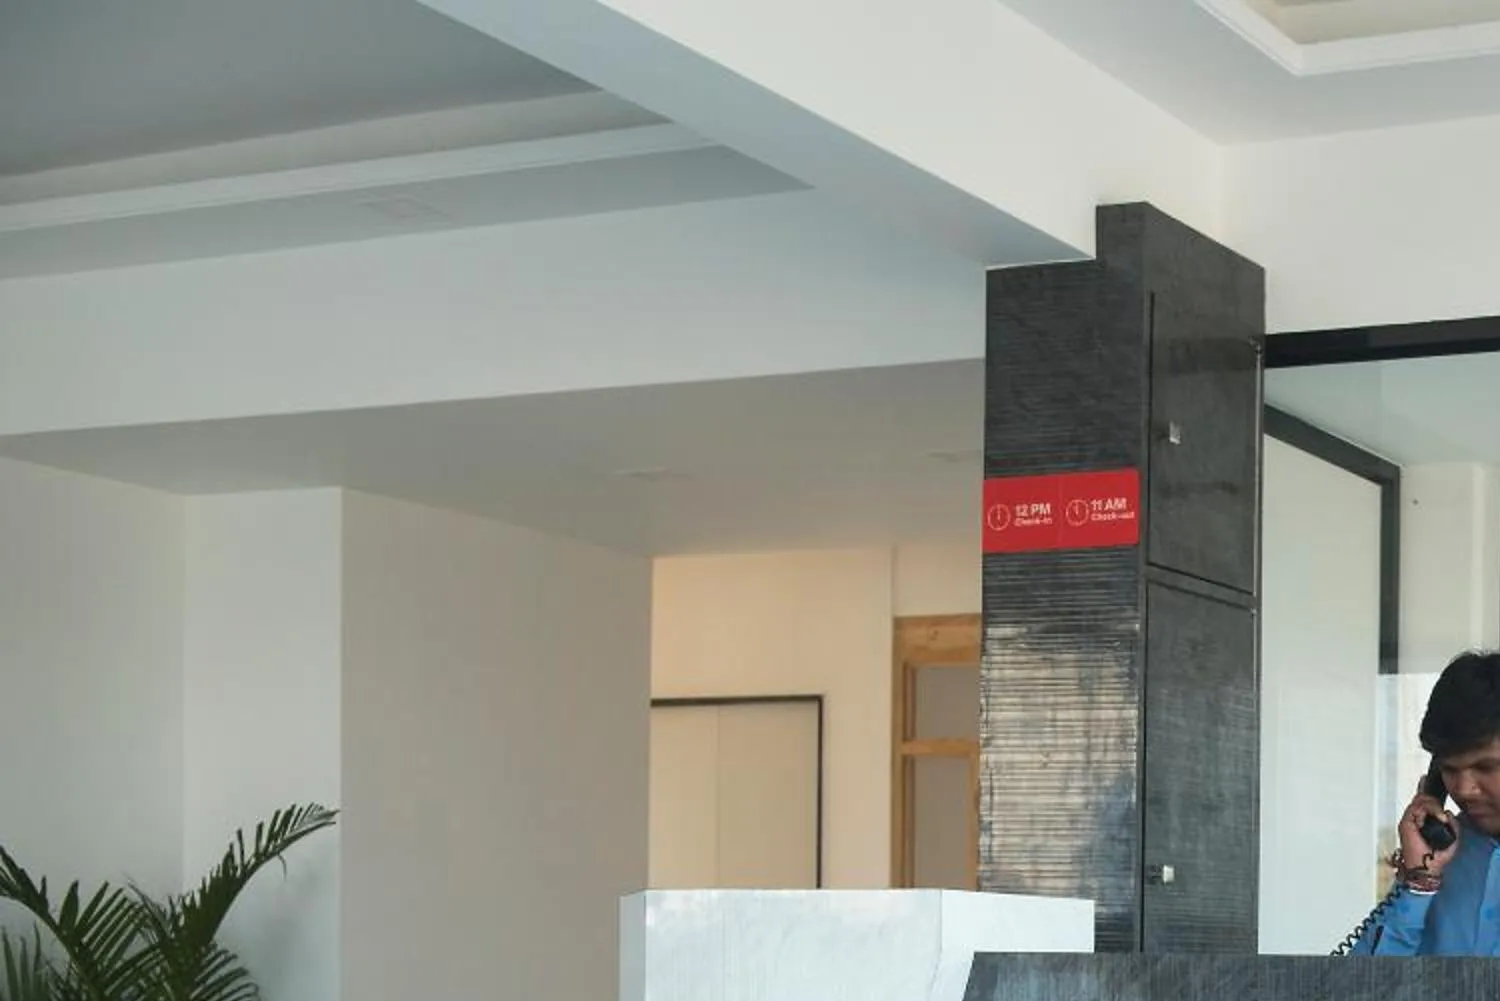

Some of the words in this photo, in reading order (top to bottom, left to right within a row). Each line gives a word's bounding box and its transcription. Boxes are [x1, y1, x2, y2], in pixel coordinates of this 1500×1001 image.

[1014, 504, 1028, 517] 12
[1030, 502, 1052, 516] PM
[1090, 499, 1101, 511] 11
[1104, 497, 1128, 510] AM
[1014, 517, 1053, 527] Check-in
